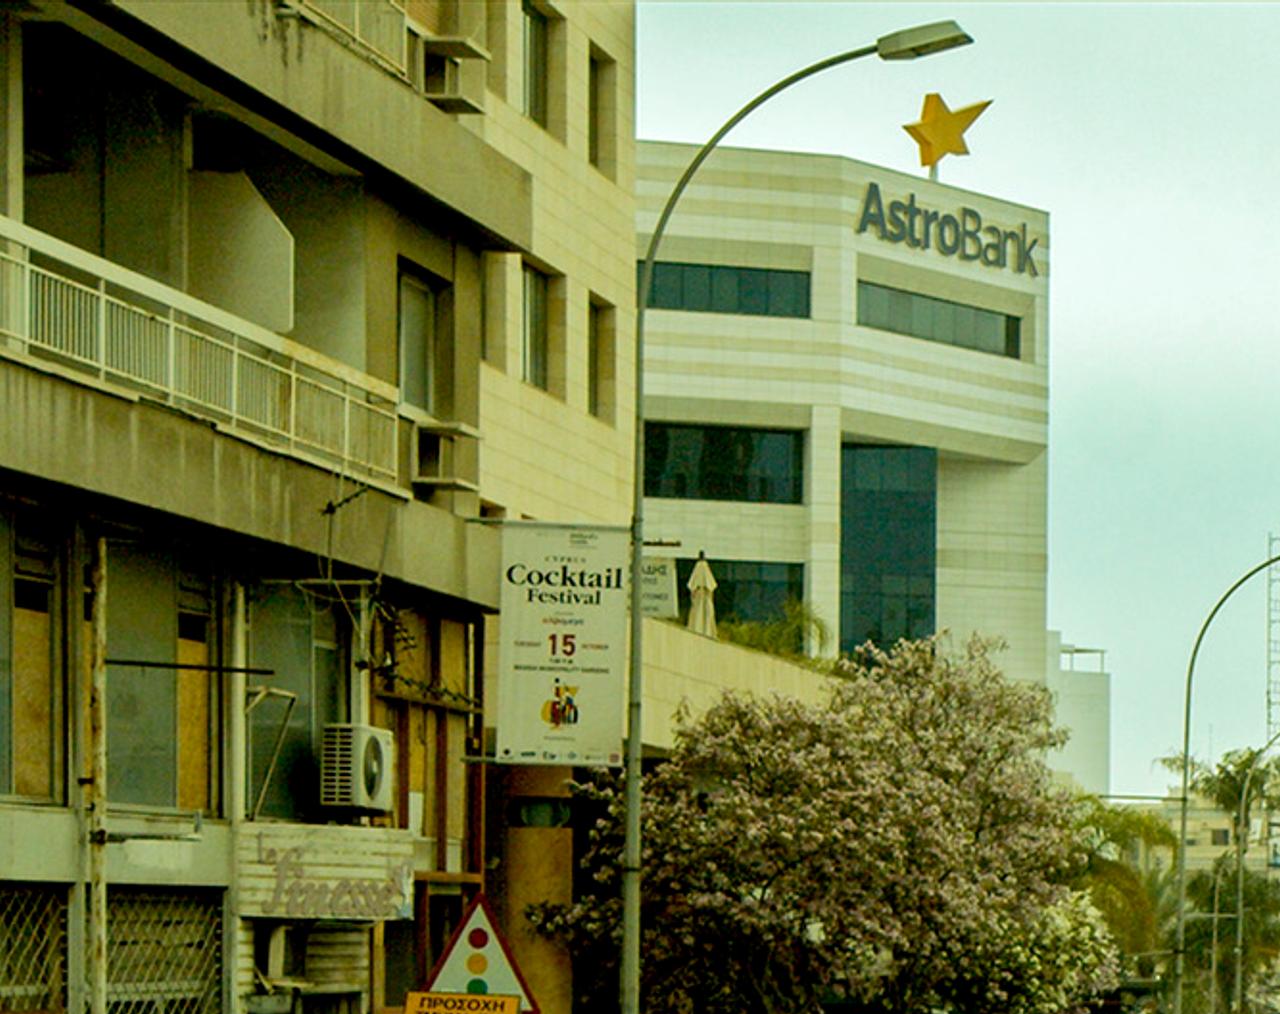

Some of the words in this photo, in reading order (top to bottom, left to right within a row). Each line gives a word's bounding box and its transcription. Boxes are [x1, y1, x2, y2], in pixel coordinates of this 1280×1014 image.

[856, 182, 1038, 278] AstroBank
[506, 564, 623, 590] Cocktail
[526, 588, 602, 606] Festival
[548, 633, 577, 656] 15
[419, 996, 505, 1012] ΠΡΟΣΟΧΗ
